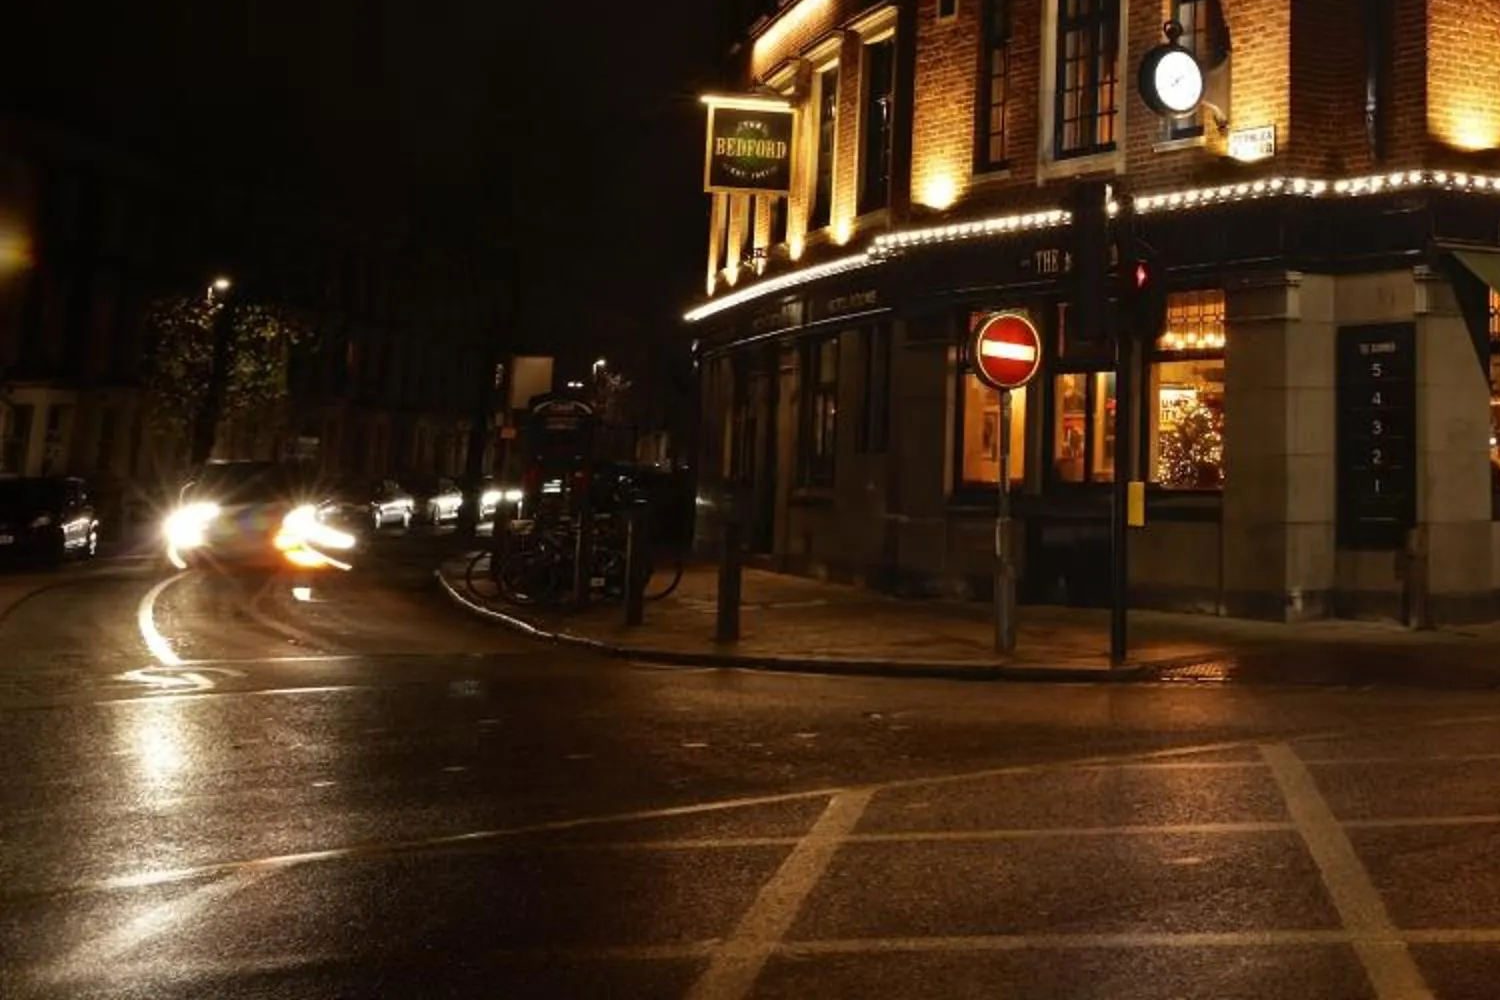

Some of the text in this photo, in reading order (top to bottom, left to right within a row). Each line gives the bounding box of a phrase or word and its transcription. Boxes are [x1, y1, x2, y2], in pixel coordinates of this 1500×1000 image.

[714, 137, 787, 160] BEDFORD
[1035, 248, 1059, 274] THE
[1371, 362, 1383, 377] 5
[1371, 391, 1383, 406] 4
[1371, 420, 1383, 435] 3
[1371, 449, 1382, 464] 2
[1374, 478, 1381, 493] 1
